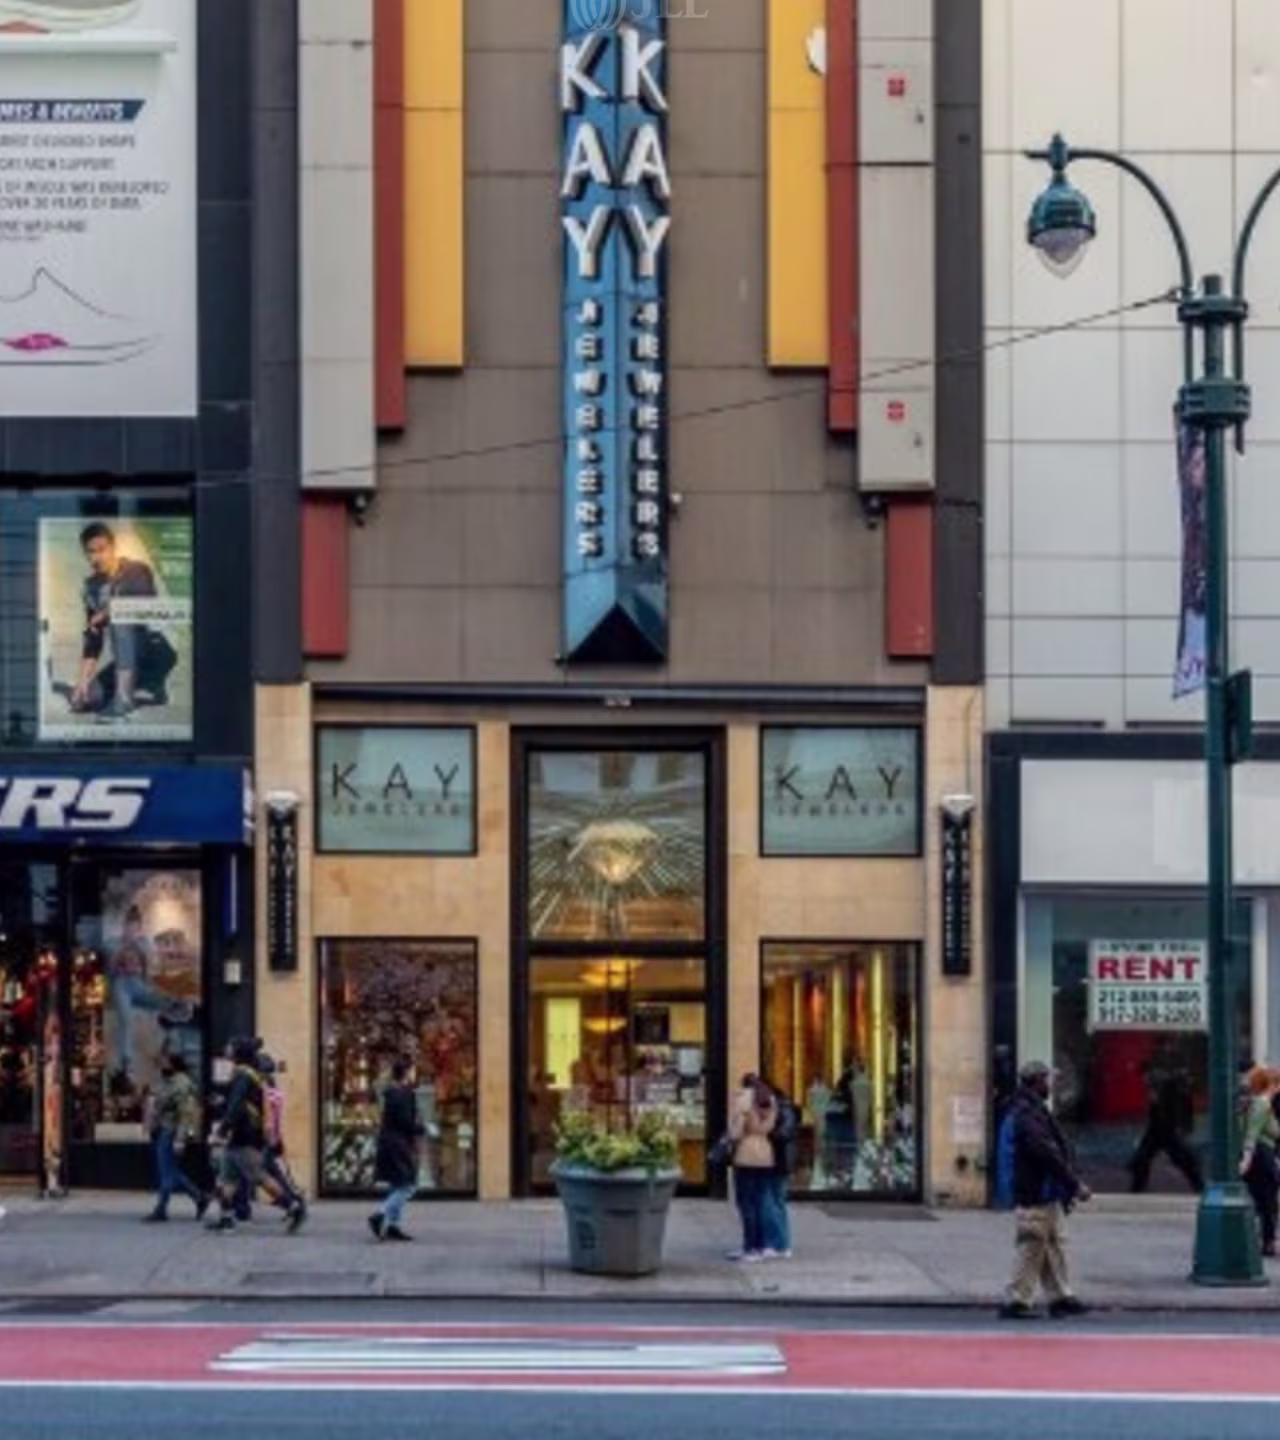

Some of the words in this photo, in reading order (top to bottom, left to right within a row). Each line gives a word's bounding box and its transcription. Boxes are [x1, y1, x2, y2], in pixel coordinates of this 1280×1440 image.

[561, 30, 611, 278] KAY
[619, 26, 671, 278] KAY
[331, 762, 459, 800] KAY
[775, 764, 903, 800] KAY
[1097, 956, 1201, 980] RENT
